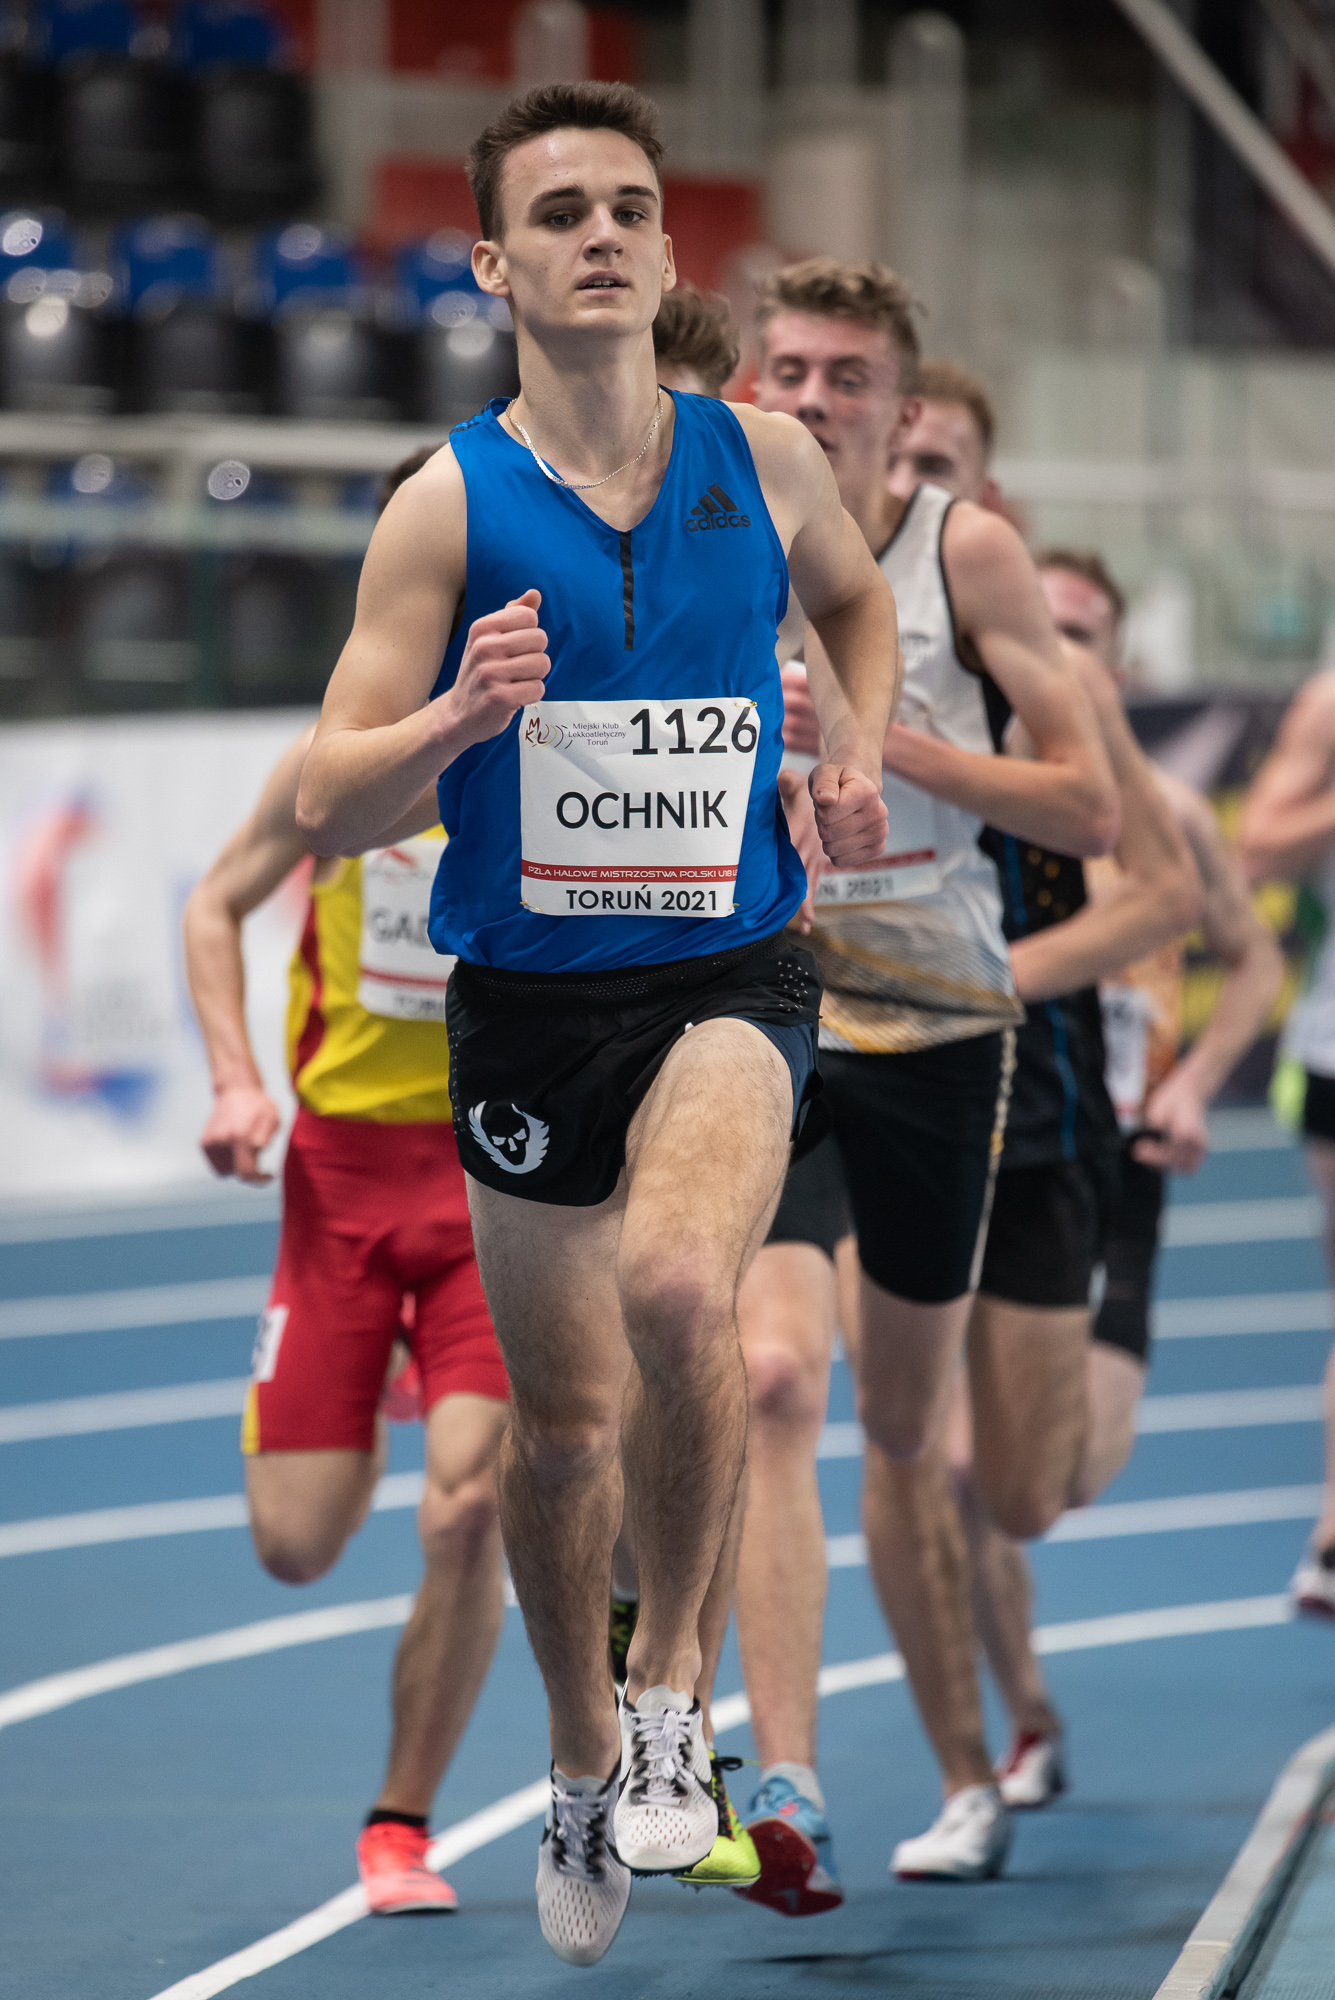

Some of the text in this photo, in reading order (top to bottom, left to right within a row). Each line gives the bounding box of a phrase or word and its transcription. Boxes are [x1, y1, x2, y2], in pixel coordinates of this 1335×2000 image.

[685, 512, 751, 532] adidas
[568, 731, 627, 740] Lekkoatletyczny
[573, 722, 620, 731] Miejski Klub
[630, 706, 757, 755] 1126
[556, 790, 729, 829] OCHNIK
[528, 866, 552, 876] PZLA
[553, 869, 598, 877] HALOWE
[600, 870, 678, 878] MISTRZOSTWA
[679, 870, 717, 878] POLSKI
[566, 884, 717, 911] TORUŃ 2021
